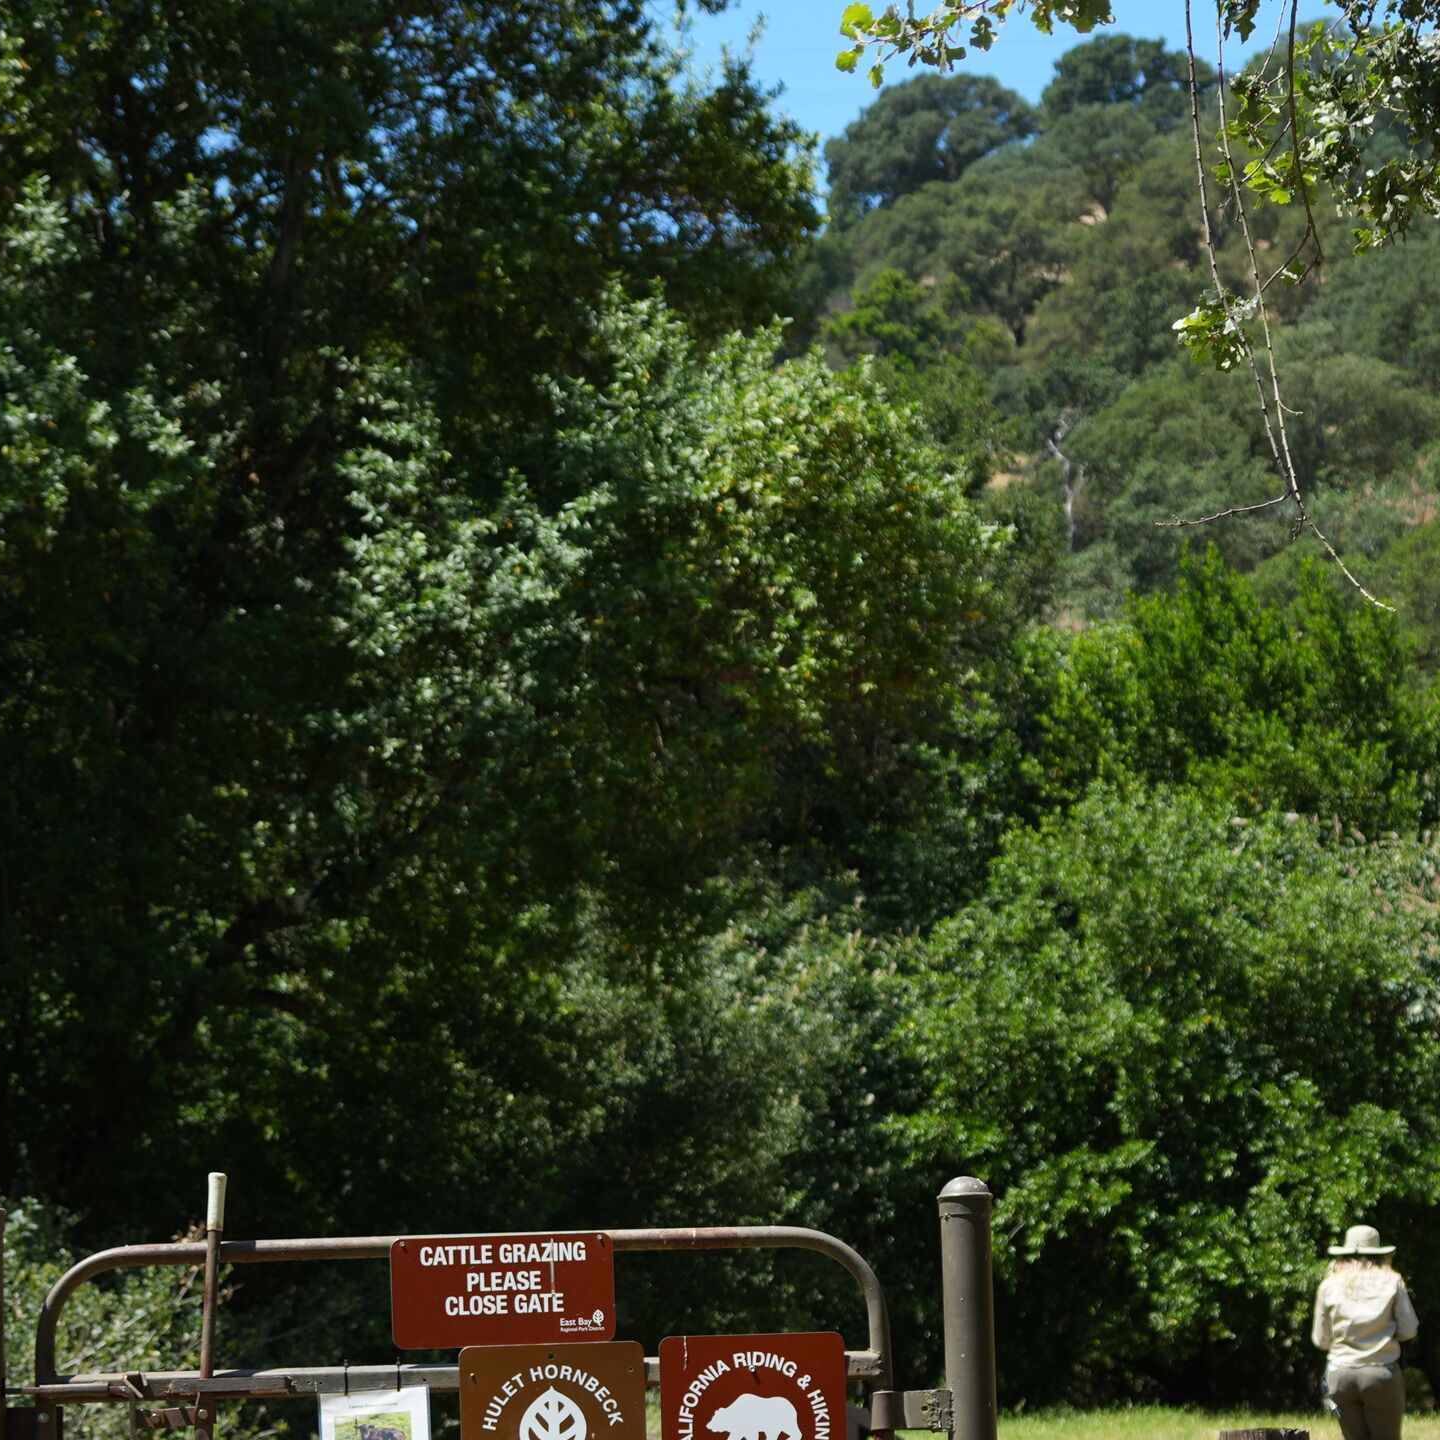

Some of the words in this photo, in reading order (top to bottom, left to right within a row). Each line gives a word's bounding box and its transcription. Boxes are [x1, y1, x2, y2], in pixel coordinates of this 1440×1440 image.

[420, 1245, 492, 1266] CATTLE
[499, 1242, 586, 1263] GRAZING
[467, 1271, 541, 1292] PLEASE
[445, 1295, 508, 1316] CLOSE
[514, 1293, 564, 1314] GATE
[560, 1318, 576, 1326] East
[578, 1317, 592, 1327] Bay
[732, 1351, 798, 1378] RIDING
[797, 1374, 811, 1390] &
[482, 1373, 525, 1431] HULET
[529, 1364, 624, 1426] HORNBECK
